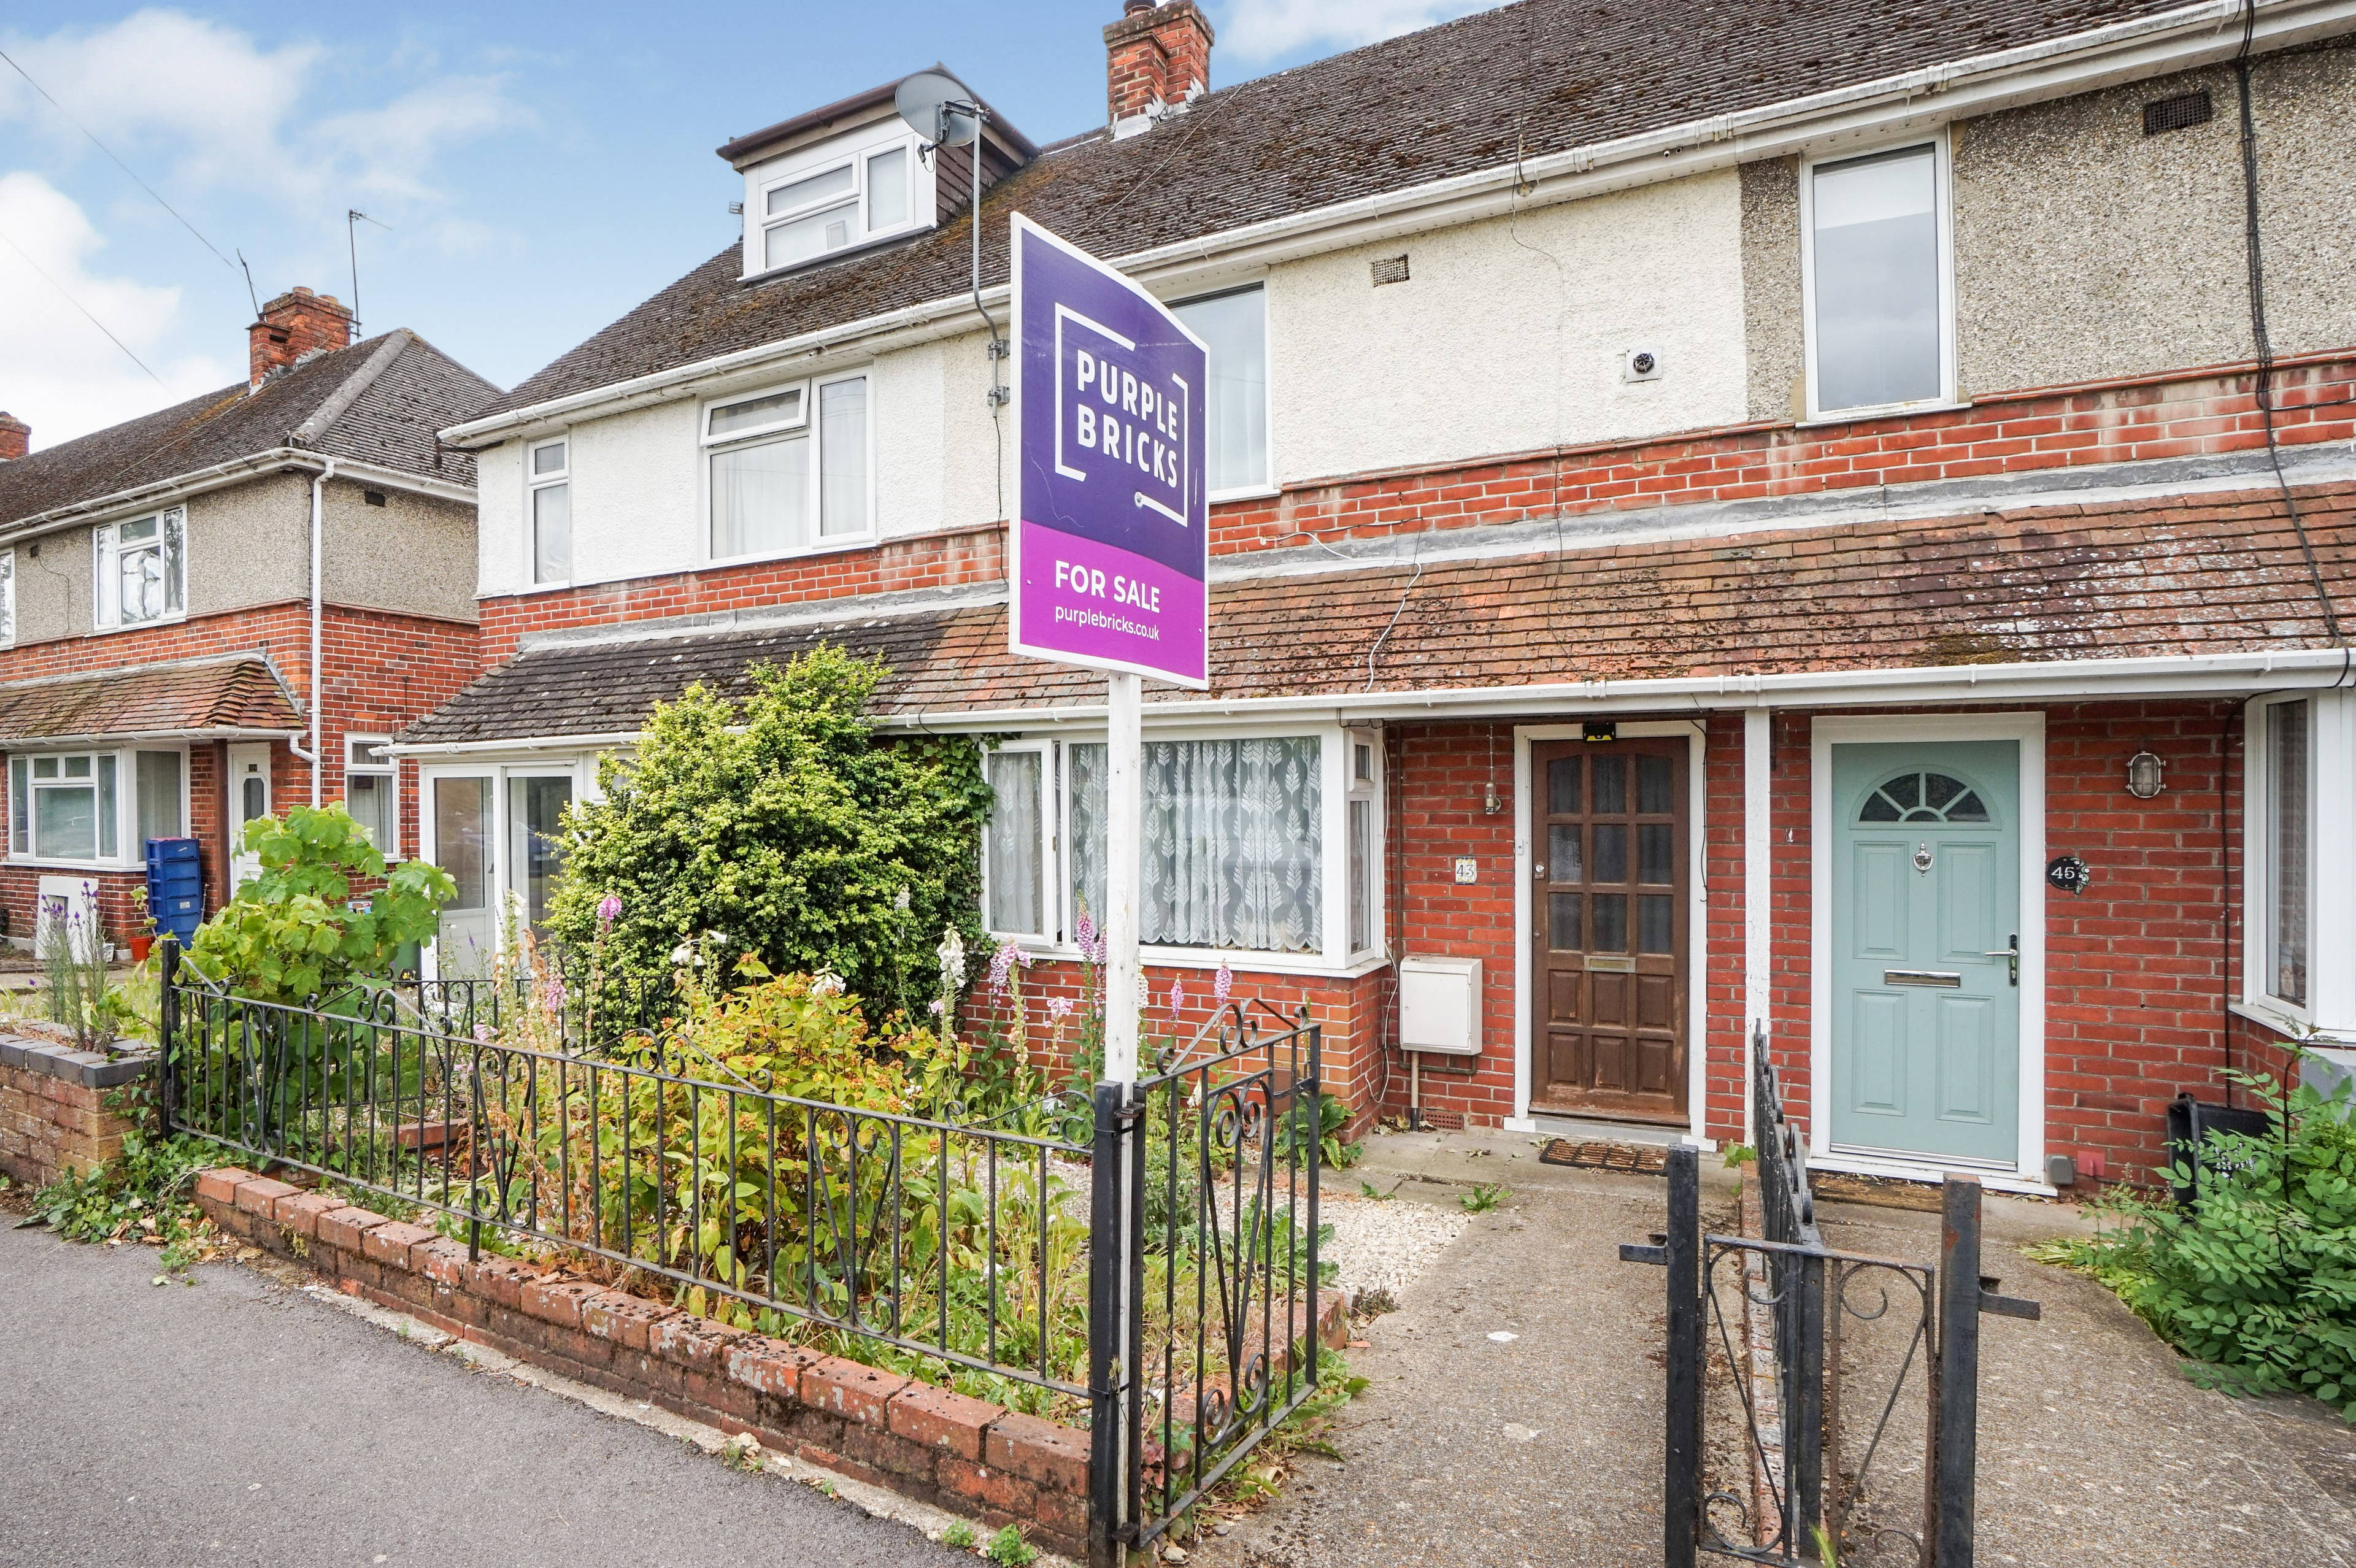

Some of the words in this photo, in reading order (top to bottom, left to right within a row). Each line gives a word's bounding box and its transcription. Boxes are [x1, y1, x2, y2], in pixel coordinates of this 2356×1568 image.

[1077, 349, 1177, 442] PURPLE
[1077, 404, 1177, 488] BRICKS
[1055, 559, 1106, 599] FOR
[1114, 575, 1160, 613] SALE
[1055, 605, 1160, 641] purplebricks.co.uk
[1457, 864, 1474, 878] 43
[2051, 866, 2075, 879] 45
